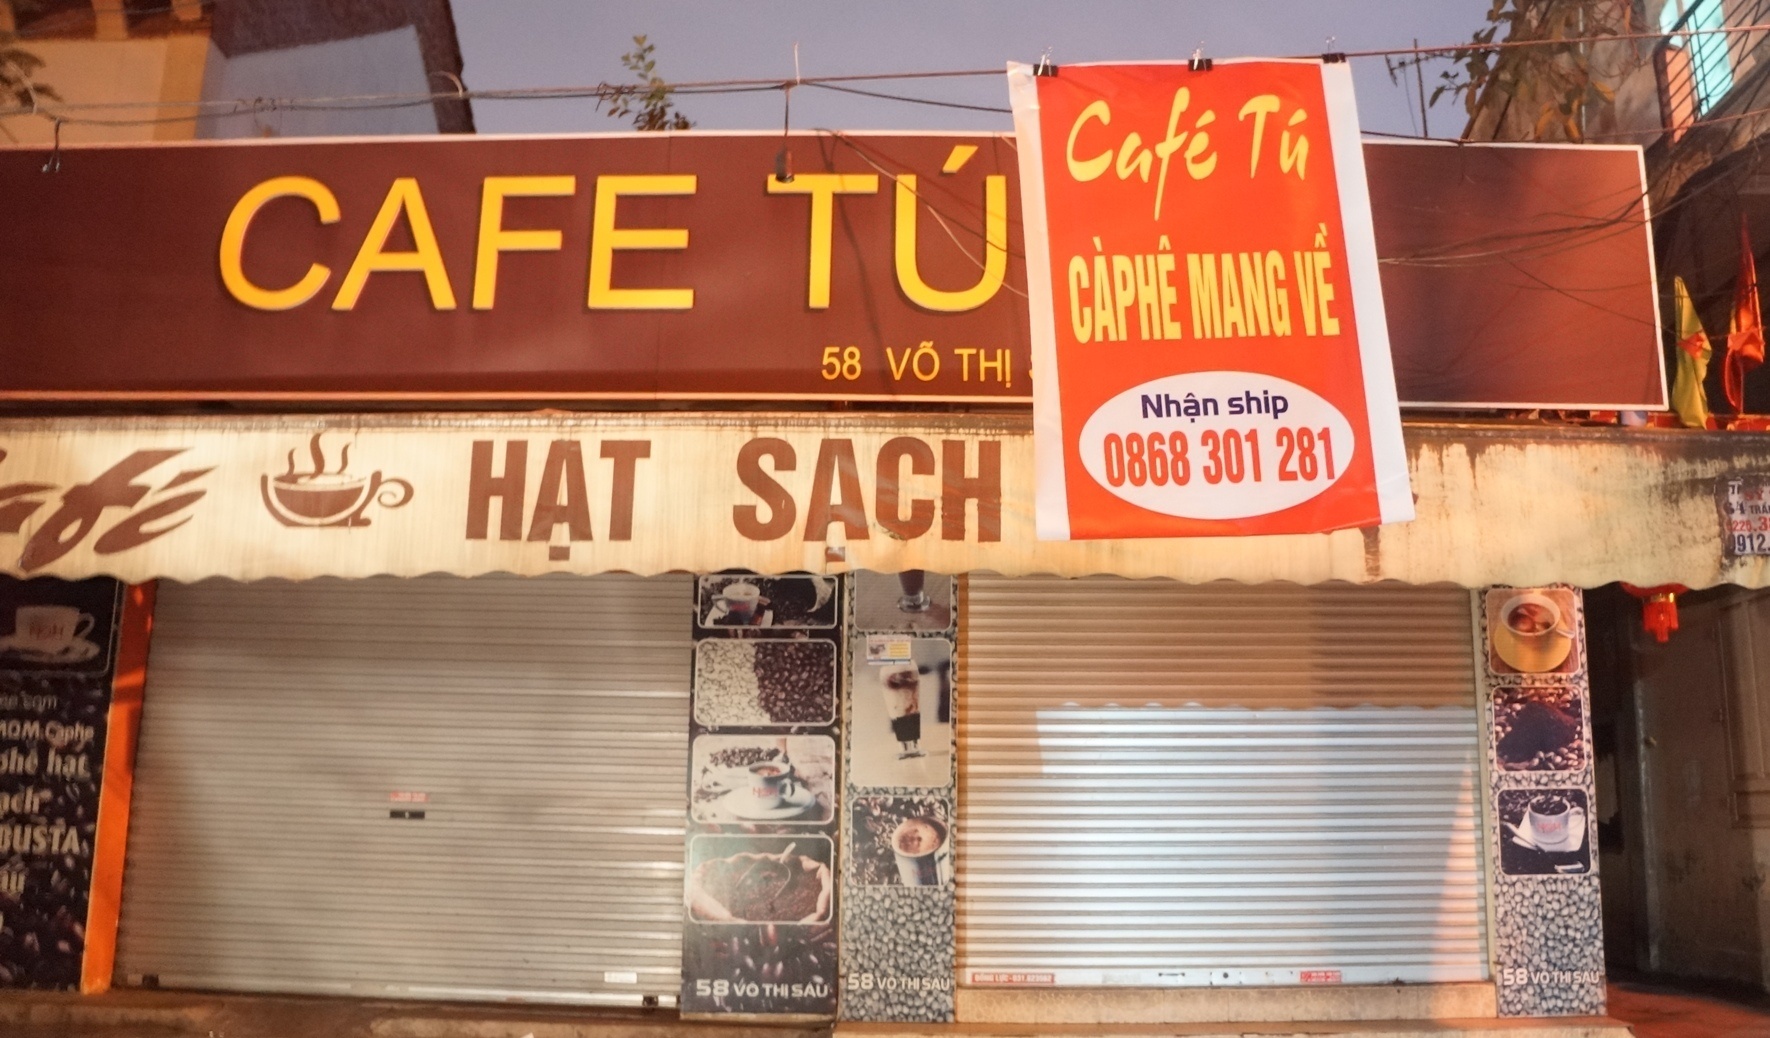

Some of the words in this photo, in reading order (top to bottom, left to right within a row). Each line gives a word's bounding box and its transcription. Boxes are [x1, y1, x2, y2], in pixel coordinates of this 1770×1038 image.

[1066, 86, 1218, 221] Café
[1238, 94, 1310, 181] Tú
[219, 175, 697, 311] CAFE
[766, 145, 1007, 312] TÚ
[1068, 234, 1182, 344] CÀPHÊ
[1186, 250, 1292, 338] MANG
[1293, 222, 1341, 337] VỀ
[821, 346, 862, 381] 58
[886, 340, 940, 381] VÕ
[954, 348, 1012, 389] THỊ
[1141, 392, 1219, 423] Nhận
[1228, 390, 1289, 420] ship
[1103, 430, 1192, 488] 0868
[1200, 428, 1262, 485] 301
[1275, 426, 1335, 482] 281
[0, 447, 219, 573] afé
[465, 439, 652, 562] HẠT
[732, 436, 1002, 563] SẠCH
[696, 979, 730, 997] 58
[848, 973, 874, 990] 58
[1503, 968, 1528, 985] 58
